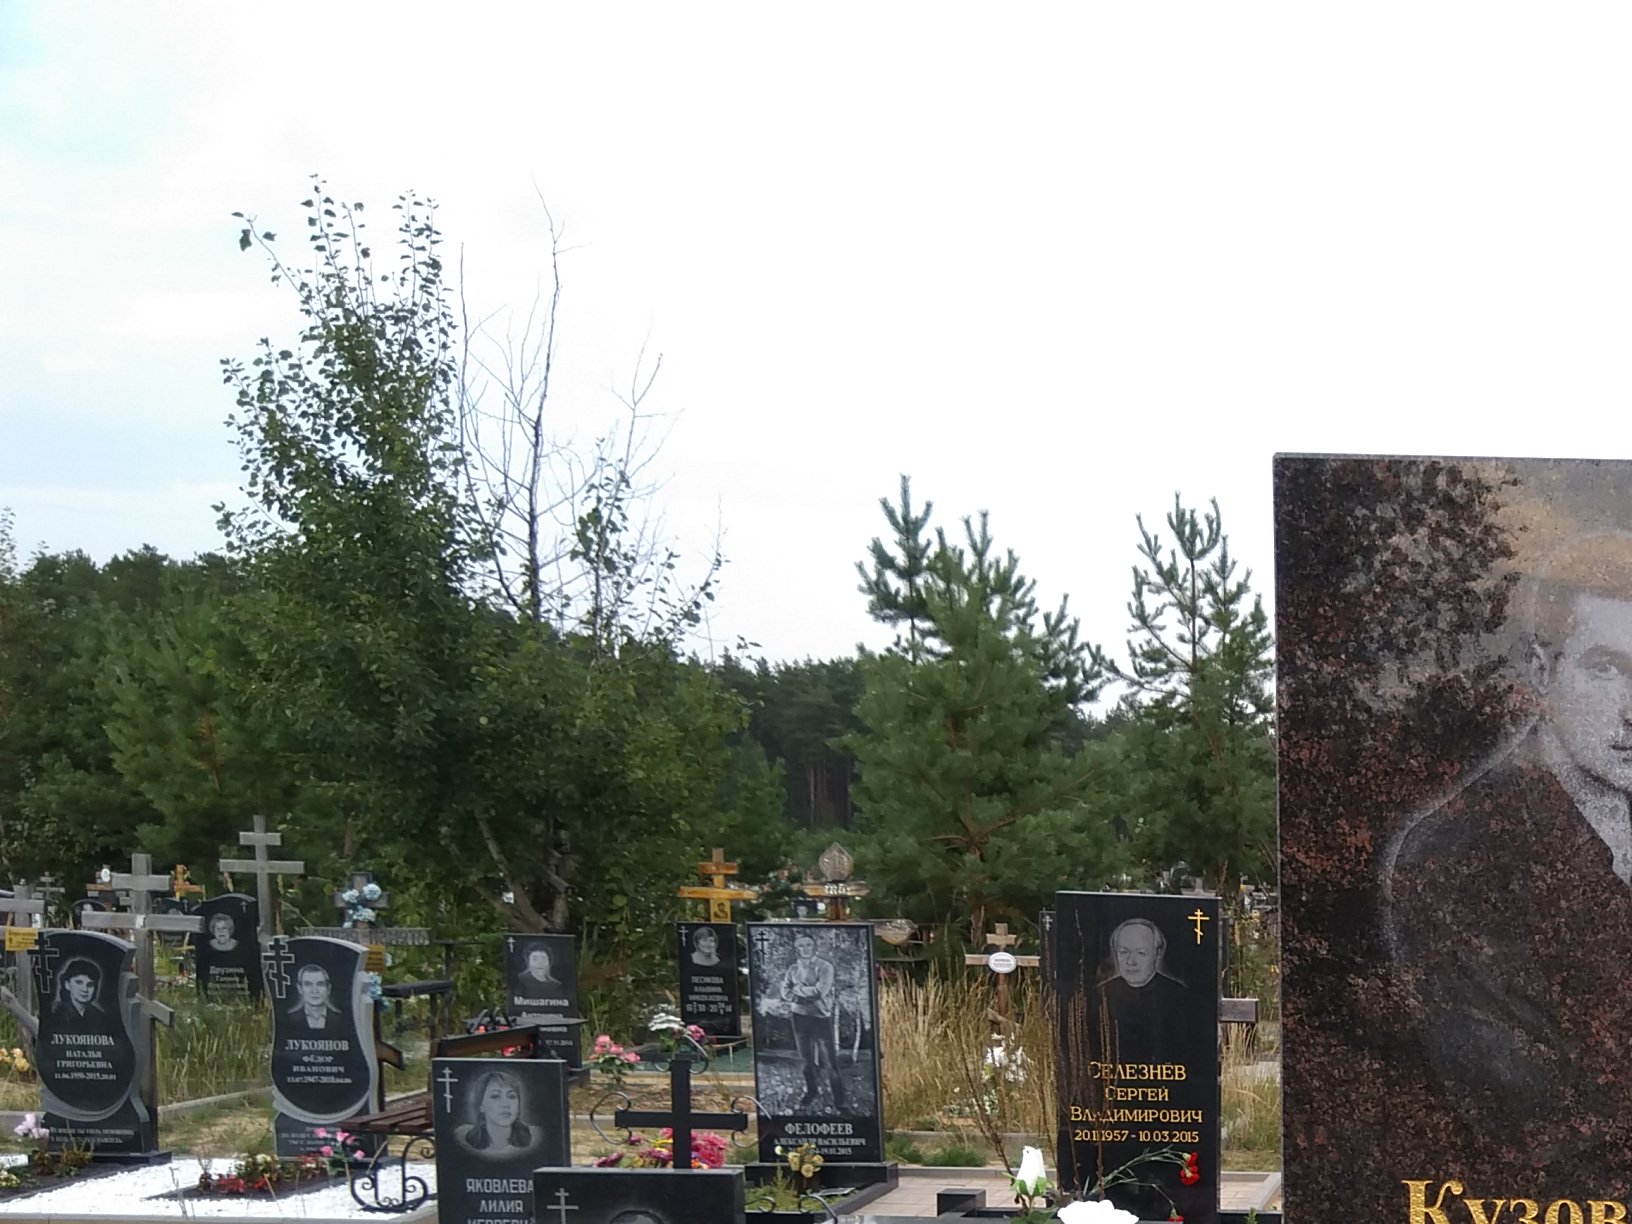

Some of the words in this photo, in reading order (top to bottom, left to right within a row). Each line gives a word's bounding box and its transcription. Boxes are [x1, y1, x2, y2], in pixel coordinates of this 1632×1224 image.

[513, 996, 569, 1006] Мишагина
[51, 1034, 115, 1046] ЛУКОЯНОВА
[285, 1040, 350, 1051] ЛУКОЯНОВ
[66, 1050, 102, 1058] НАТАЛЬЯ
[56, 1060, 113, 1069] ГРИГОРЬЕВНА
[1105, 1085, 1169, 1102] СЕРГЕЙ
[1074, 1129, 1129, 1142] 20.111957
[1139, 1130, 1200, 1143] 10.03.2015
[466, 1179, 535, 1194] ЯКОВЛЕВА
[480, 1199, 524, 1213] ЛИЛИЯ
